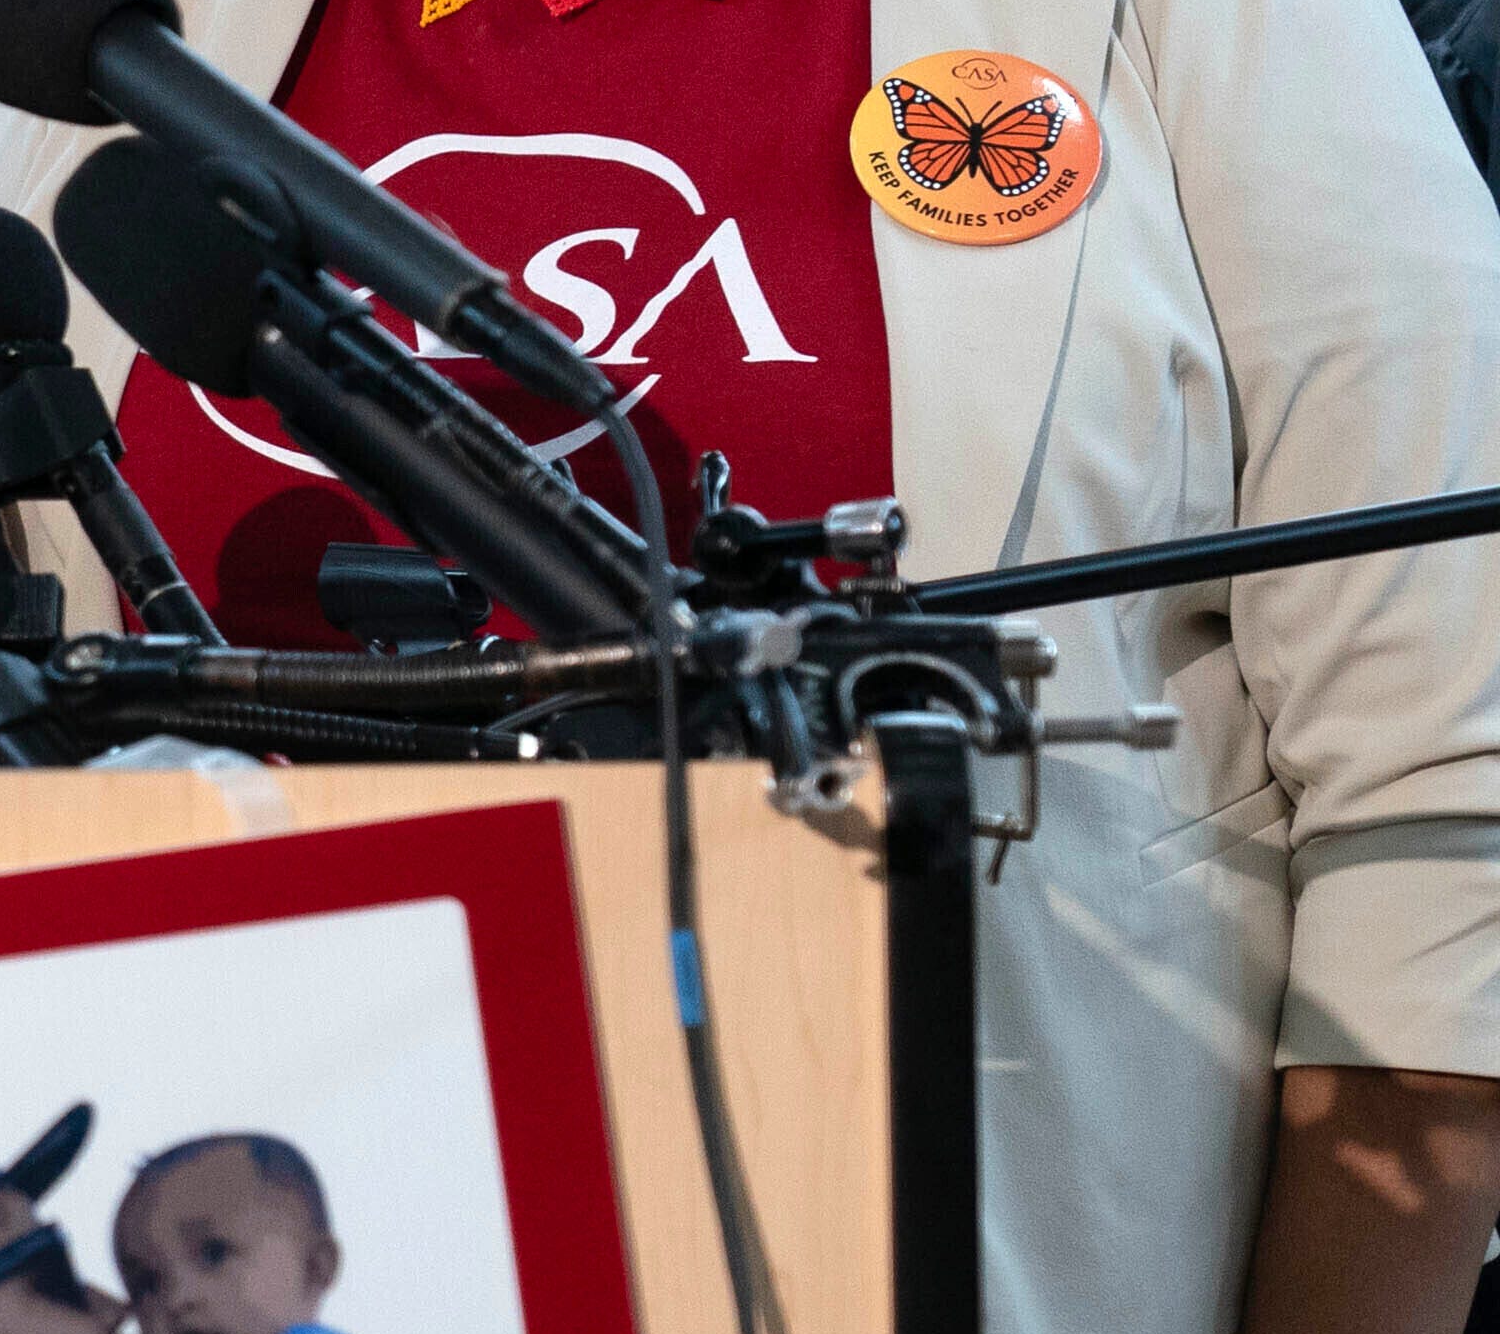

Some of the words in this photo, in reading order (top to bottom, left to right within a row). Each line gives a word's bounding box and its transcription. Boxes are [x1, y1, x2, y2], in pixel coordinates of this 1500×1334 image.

[951, 63, 1008, 84] CASA
[868, 150, 901, 189] KEEP
[898, 189, 988, 228] FAMILIES
[992, 167, 1080, 226] TOGETHER
